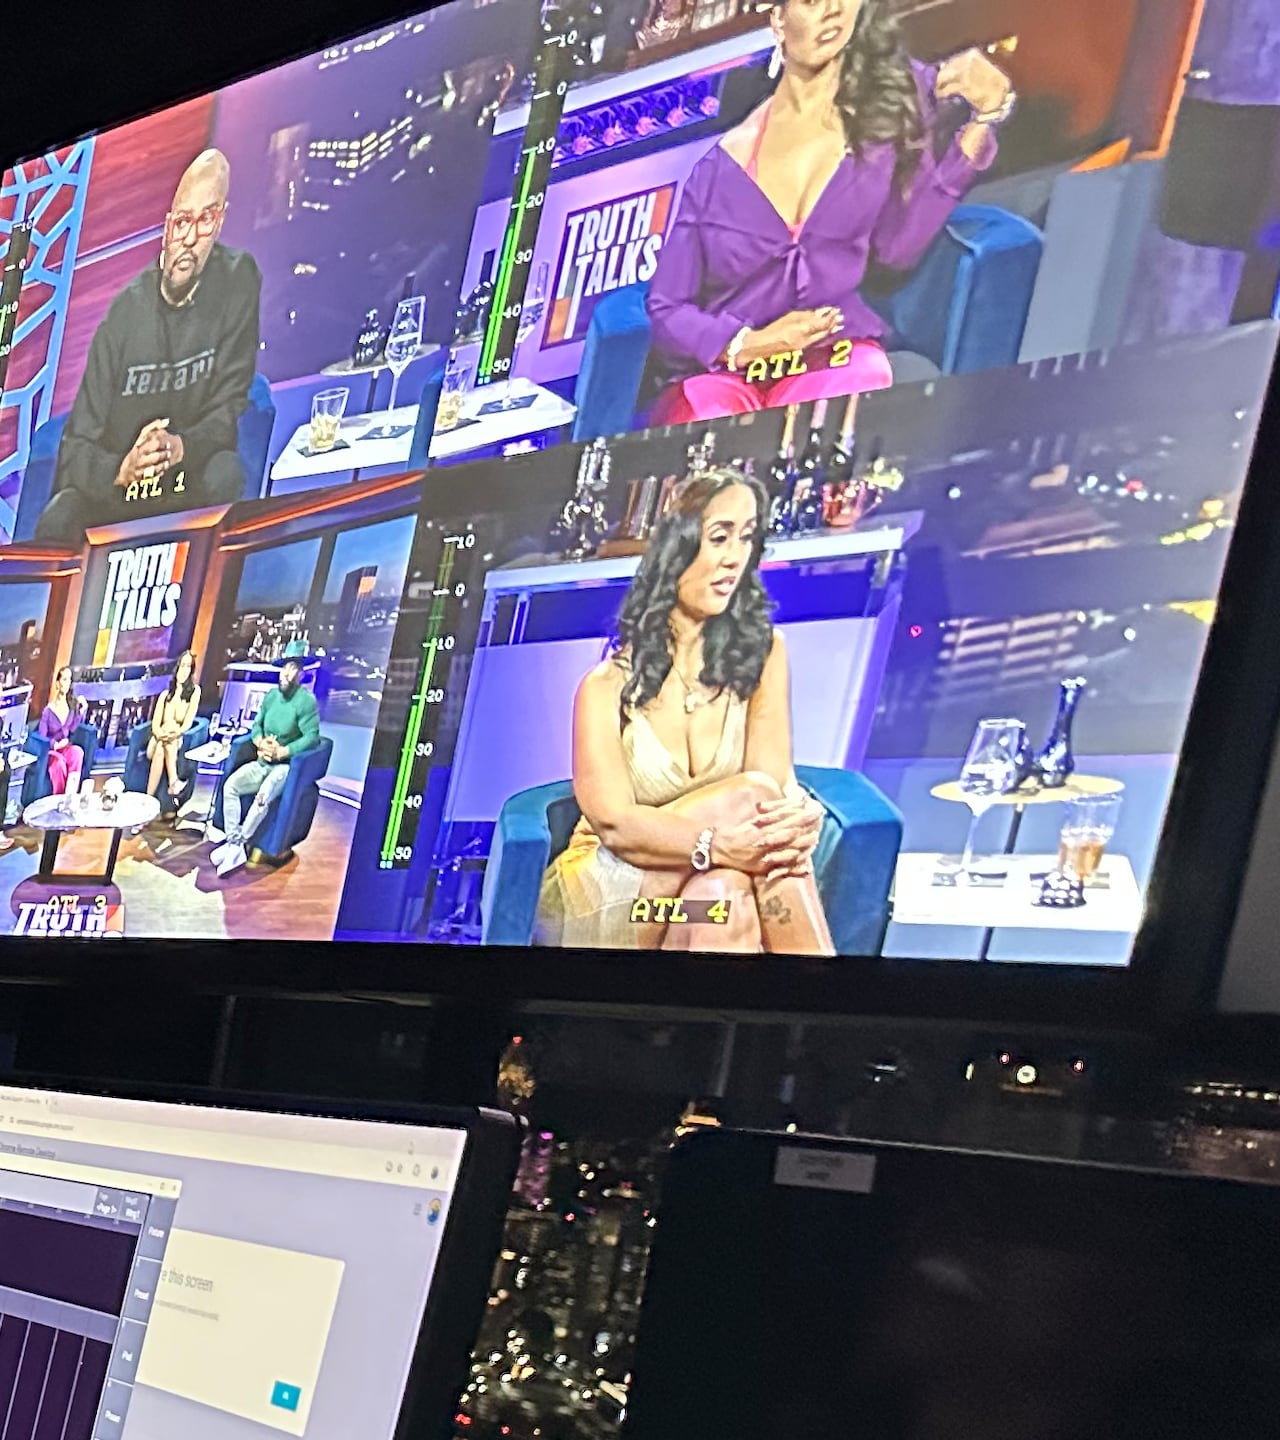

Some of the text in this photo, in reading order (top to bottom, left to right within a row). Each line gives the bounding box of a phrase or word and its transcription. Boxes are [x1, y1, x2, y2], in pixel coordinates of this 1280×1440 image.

[556, 191, 657, 300] TRUTH
[121, 348, 216, 397] Ferrari
[746, 339, 852, 383] ATL 2
[125, 471, 186, 502] ATL 1
[456, 534, 475, 549] 10
[99, 542, 178, 630] TRUTH
[47, 895, 81, 914] ATL
[630, 897, 729, 923] ATL 4
[169, 1268, 213, 1292] this screen
